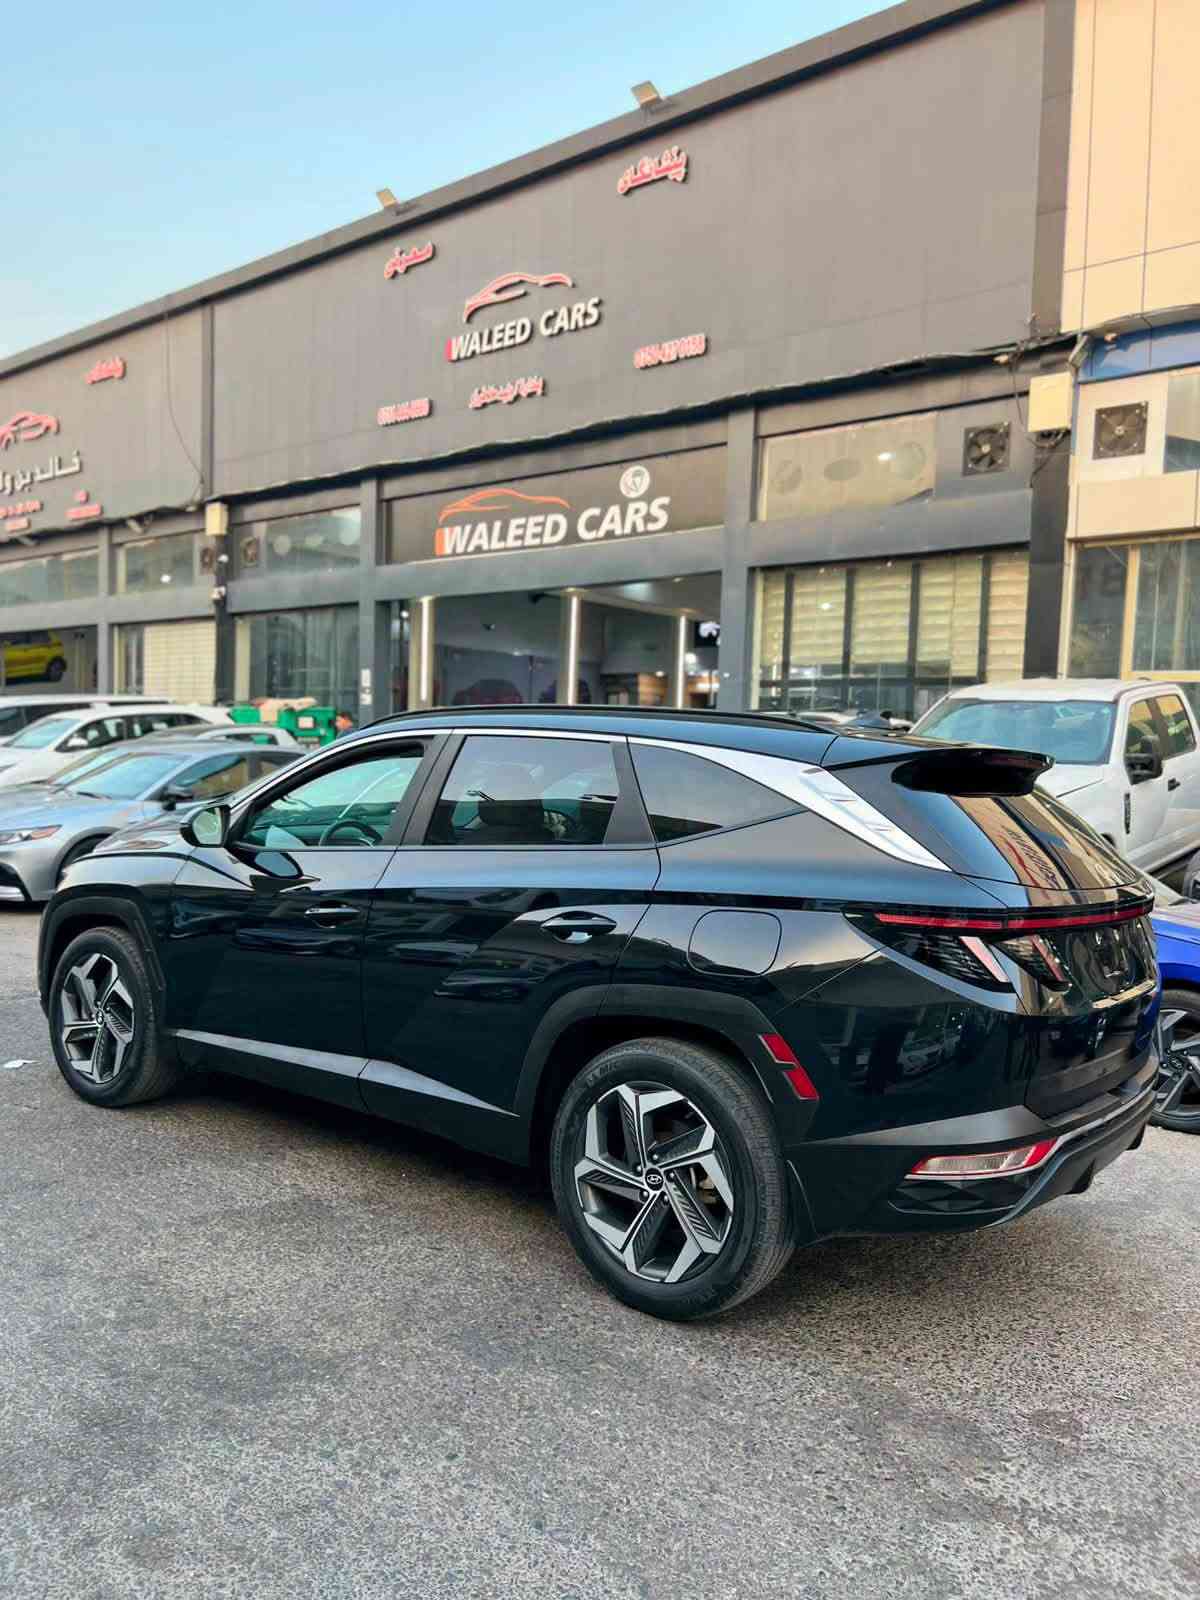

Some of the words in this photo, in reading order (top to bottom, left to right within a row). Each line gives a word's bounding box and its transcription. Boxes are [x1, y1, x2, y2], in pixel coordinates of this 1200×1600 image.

[448, 316, 532, 361] WALEED
[539, 297, 601, 337] CARS
[440, 512, 568, 555] WALEED
[576, 496, 671, 540] CARS
